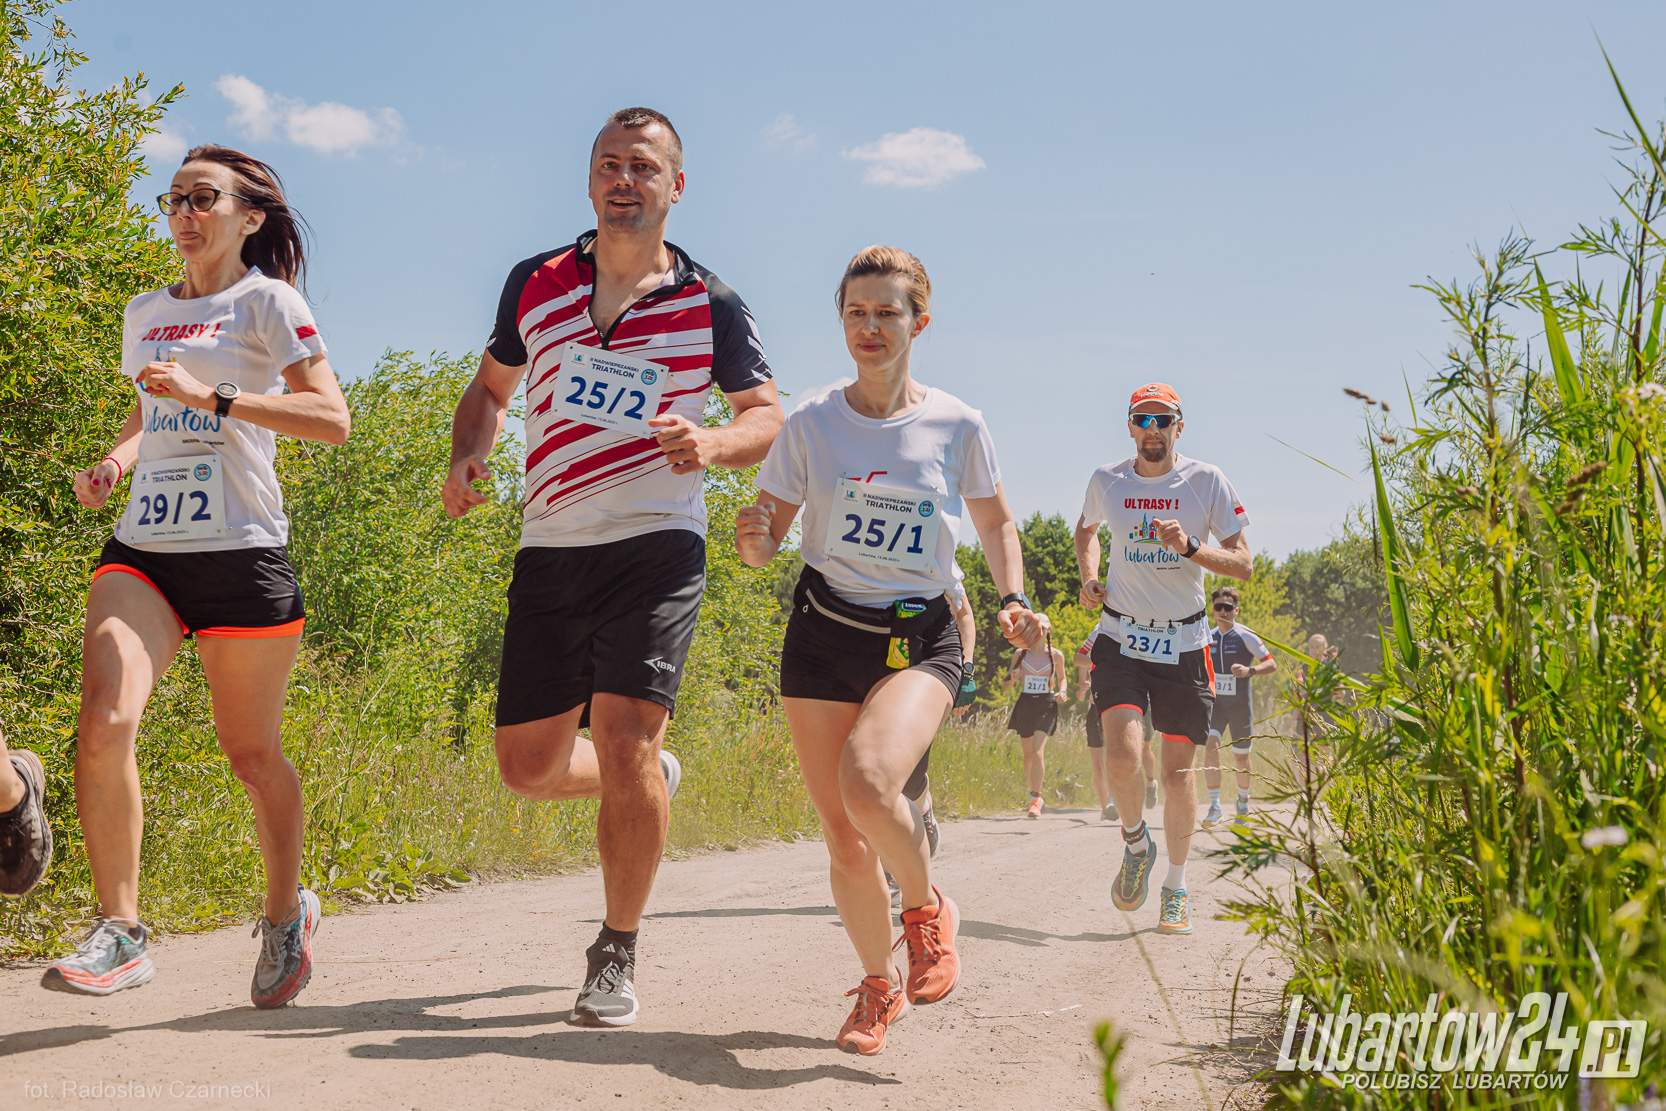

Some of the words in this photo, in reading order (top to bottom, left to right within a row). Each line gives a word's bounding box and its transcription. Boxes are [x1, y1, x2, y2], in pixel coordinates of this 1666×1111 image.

[212, 322, 222, 338] !
[591, 363, 635, 379] TRIATHLON
[565, 376, 646, 420] 25/2
[138, 490, 211, 526] 29/2
[865, 499, 912, 513] TRIATHLON
[1124, 498, 1172, 510] ULTRASY
[1174, 498, 1180, 510] !
[842, 513, 924, 554] 25/1
[1127, 634, 1172, 655] 23/1
[1027, 681, 1047, 691] 21/1
